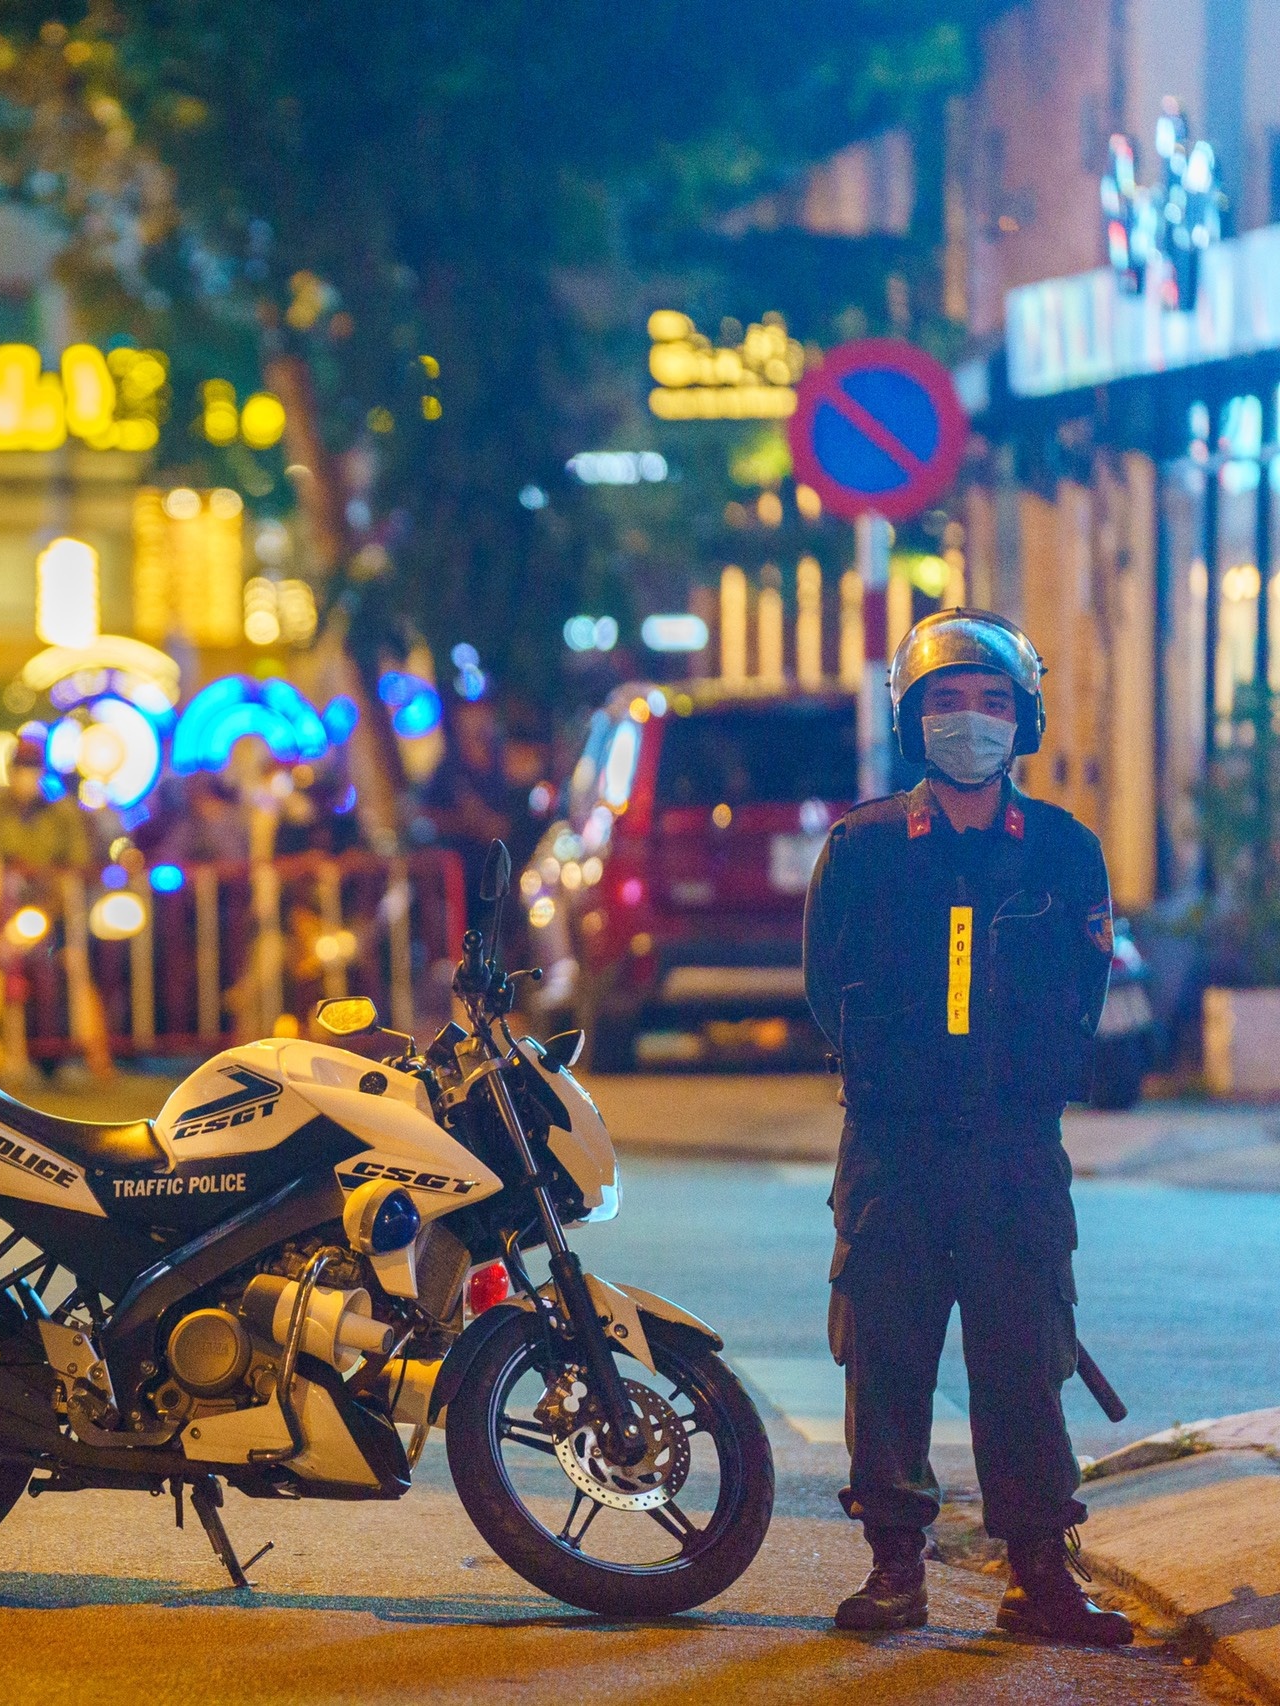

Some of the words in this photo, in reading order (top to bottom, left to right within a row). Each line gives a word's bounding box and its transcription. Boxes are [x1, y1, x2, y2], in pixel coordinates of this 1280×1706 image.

[954, 923, 966, 1020] POCE
[173, 1100, 279, 1140] CSGT
[112, 1177, 184, 1198] TRAFFIC
[188, 1172, 247, 1195] POLICE
[352, 1161, 481, 1195] CSGT
